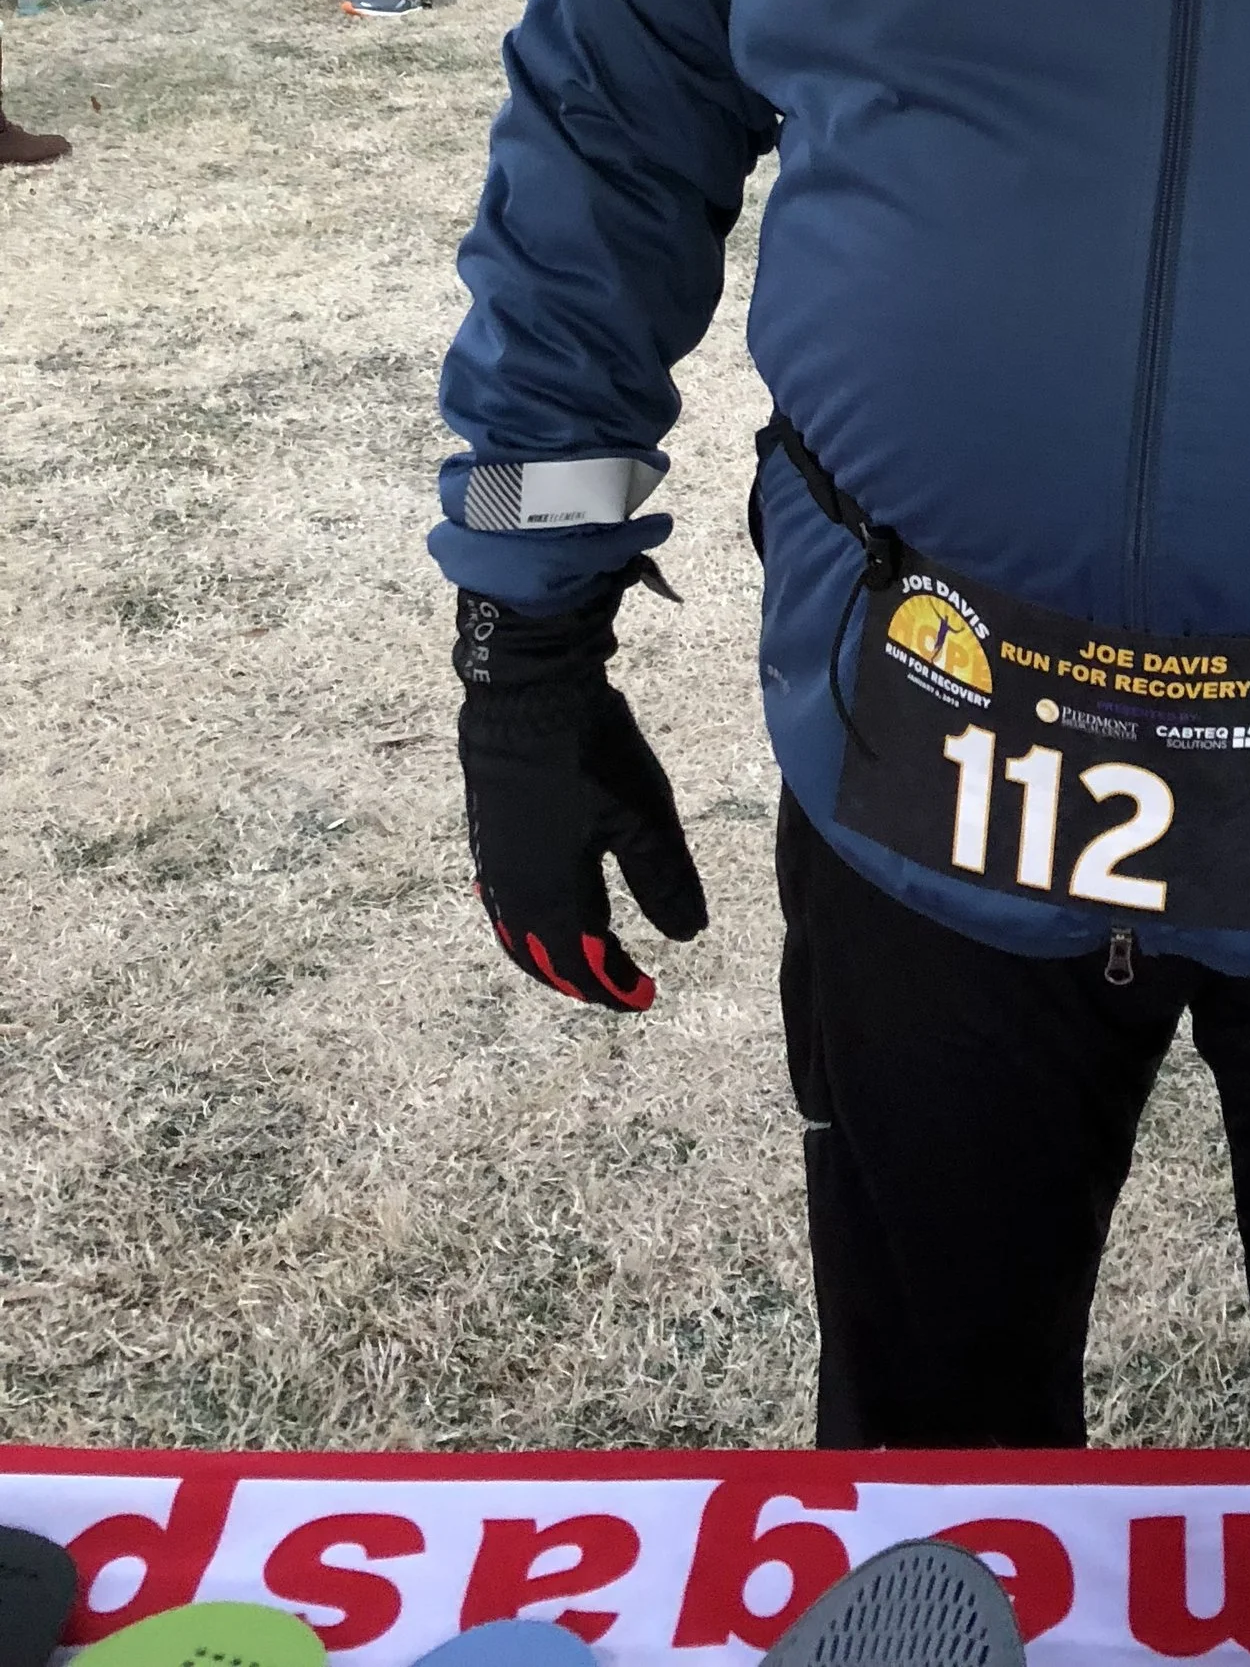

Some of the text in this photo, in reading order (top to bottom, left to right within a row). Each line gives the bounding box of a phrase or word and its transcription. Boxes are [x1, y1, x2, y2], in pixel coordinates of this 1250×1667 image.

[527, 514, 548, 523] NIKE
[902, 575, 991, 640] JOE DAVIS
[473, 600, 500, 684] GORE
[1000, 640, 1050, 673] RUN
[1057, 659, 1107, 687] FOR
[1079, 641, 1228, 675] JOE DAVIS
[885, 642, 992, 709] RUN FOR RECOVERY
[1062, 706, 1139, 733] PIEDMONT
[1166, 739, 1228, 750] SOLUTIONS
[943, 723, 1175, 913] 112
